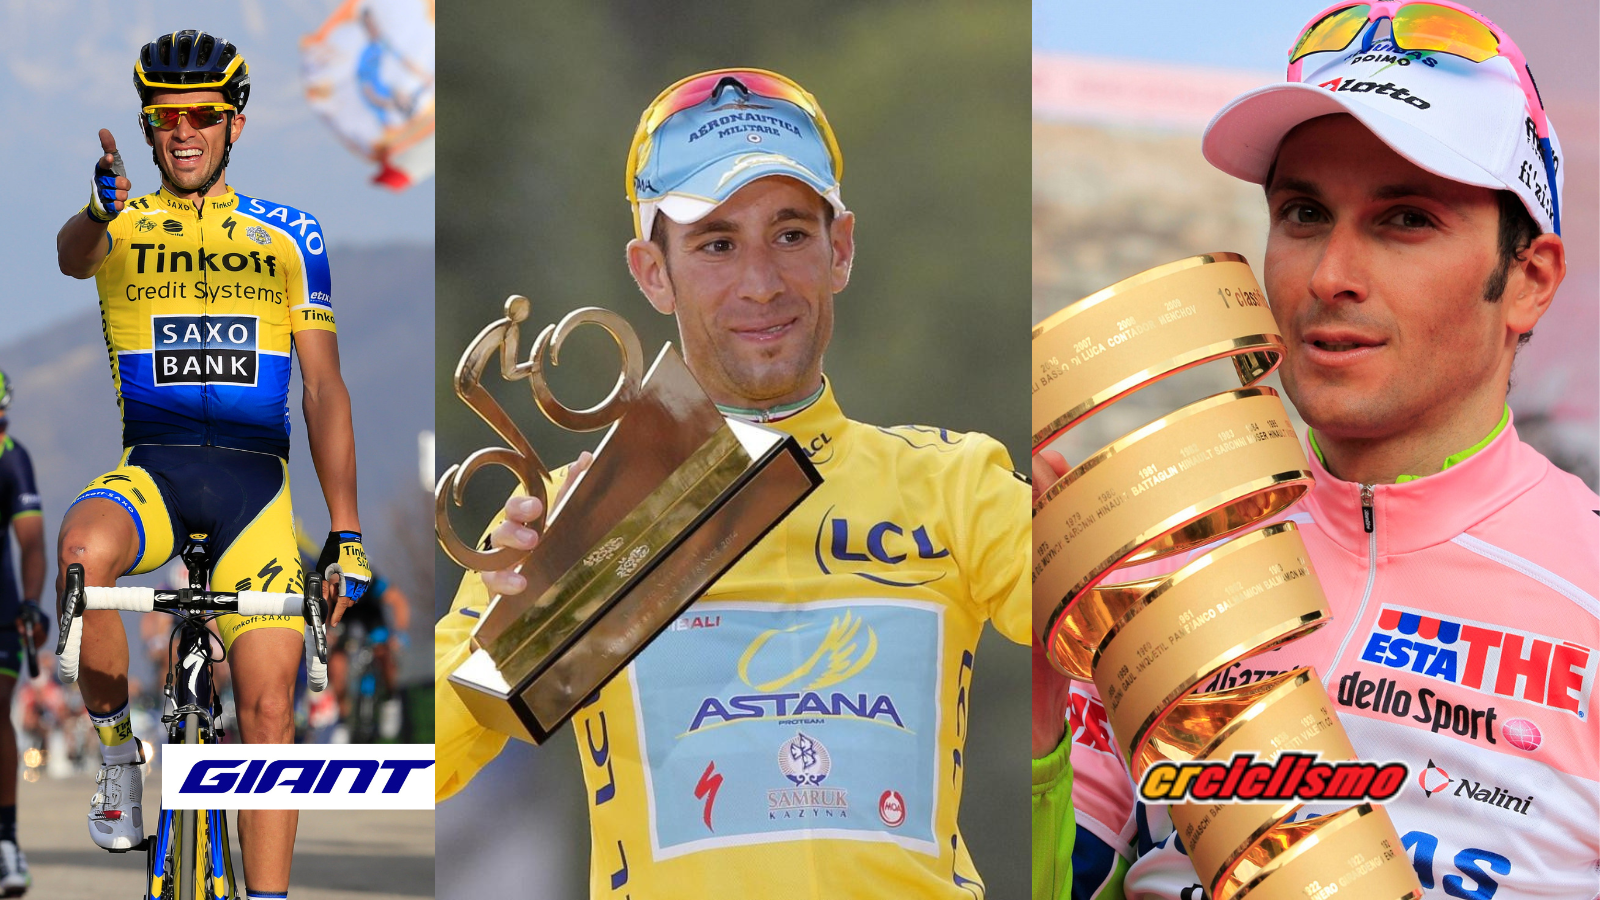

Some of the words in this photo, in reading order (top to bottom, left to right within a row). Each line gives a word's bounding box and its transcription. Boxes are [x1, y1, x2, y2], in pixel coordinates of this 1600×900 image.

[1351, 54, 1410, 66] DOIMO
[688, 112, 803, 143] AERONAUTICA
[718, 124, 780, 138] MILITARE
[167, 199, 190, 211] SAXO
[249, 198, 324, 256] SAXO
[131, 243, 277, 277] Tinkoff
[126, 281, 187, 302] Credit
[194, 281, 282, 305] Systems
[162, 322, 248, 345] SAXO
[1073, 336, 1092, 353] 2007
[1081, 343, 1106, 361] LUCA
[1107, 320, 1155, 347] CONTADOR
[163, 354, 249, 377] BANK
[804, 432, 833, 458] LCL
[1138, 463, 1158, 479] 1981
[1064, 514, 1096, 544] SARONNI
[1130, 464, 1179, 496] BATTAGLIN
[831, 518, 950, 564] LCL
[1178, 608, 1194, 626] 961
[688, 691, 906, 732] ASTANA
[1337, 671, 1412, 718] dello
[1411, 688, 1498, 745] Sport
[778, 718, 825, 726] PROTEAM
[768, 790, 848, 807] SAMRUK
[1453, 778, 1534, 816] Nalini
[769, 809, 847, 819] KAZYNA
